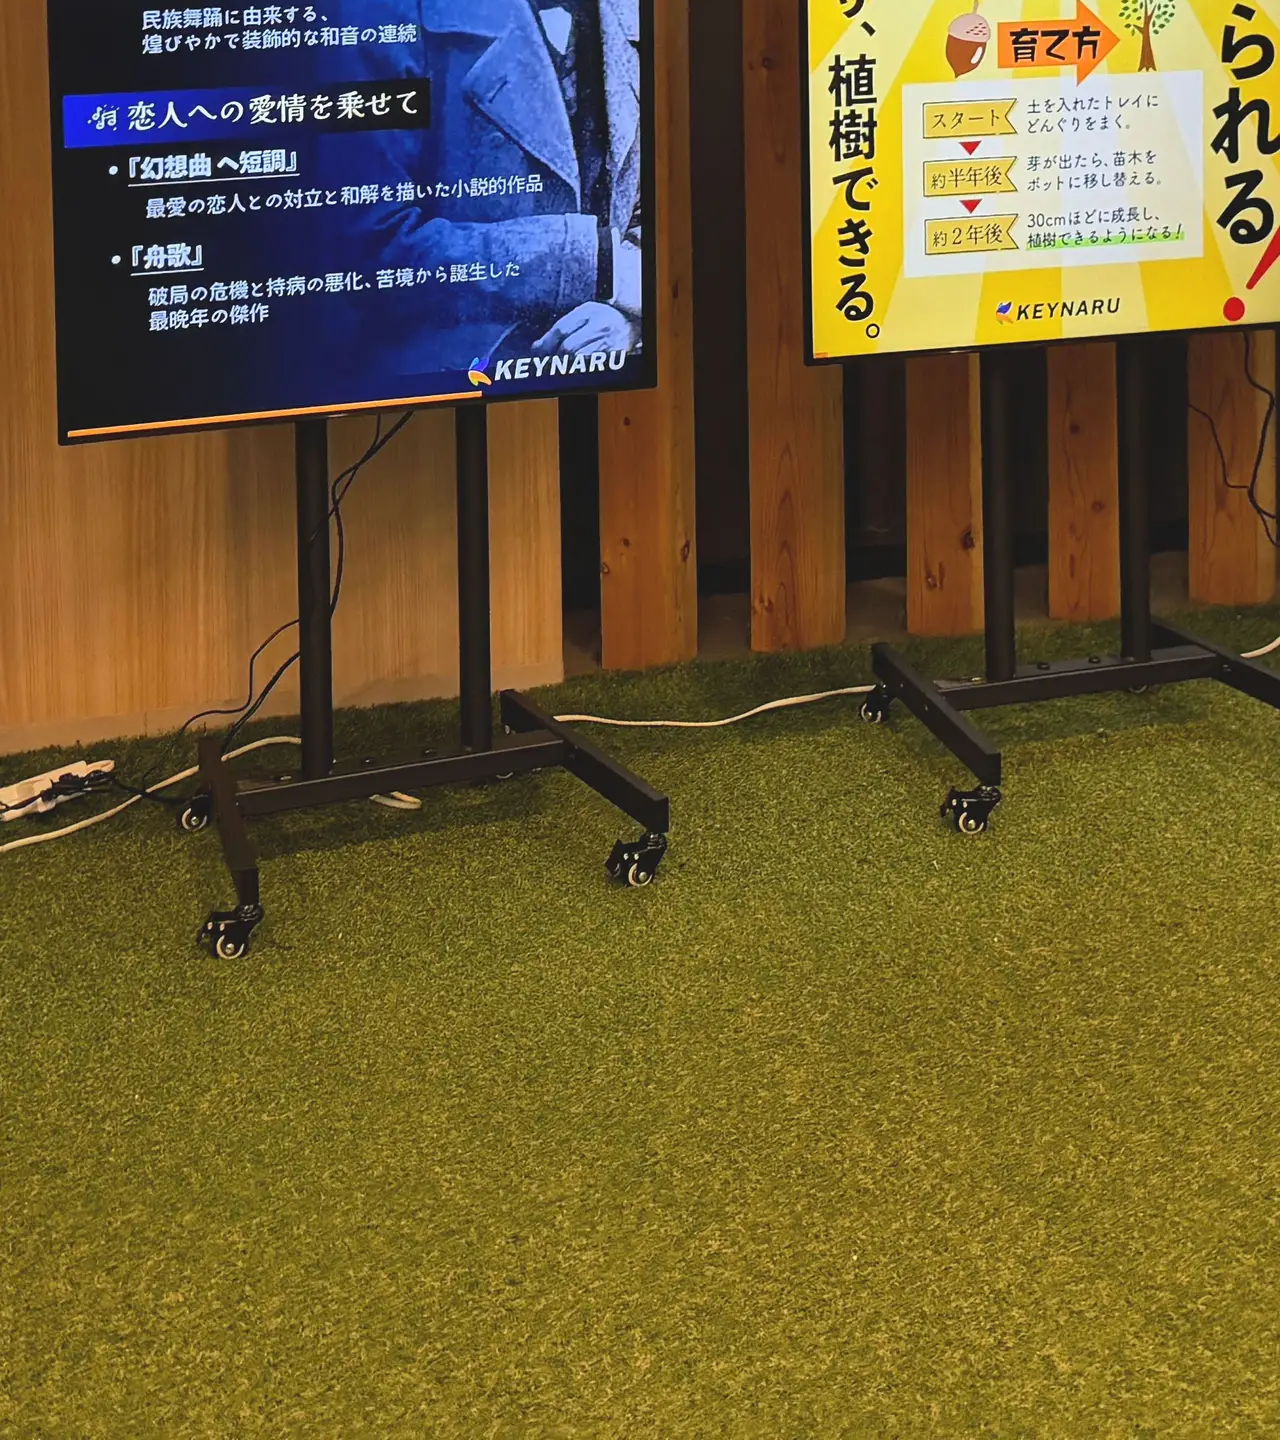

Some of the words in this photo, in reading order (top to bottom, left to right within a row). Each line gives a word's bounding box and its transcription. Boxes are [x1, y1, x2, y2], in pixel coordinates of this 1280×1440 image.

[142, 5, 329, 29] 民族舞踊に由来する、
[142, 23, 418, 54] 煌びやかで装飾的な和音の連続
[1009, 26, 1101, 63] 育て方
[127, 91, 418, 131] 恋人への愛情を乗せて
[1027, 93, 1159, 113] 土を入れたトレイに
[932, 110, 1002, 130] スタート
[1027, 113, 1133, 134] どんぐりをまく。
[1027, 150, 1157, 171] 芽が出たら、苗木を
[931, 165, 1003, 191] 約半年後
[1027, 171, 1162, 191] ポットに移し替える。
[145, 176, 544, 219] 最愛の恋人との対立と和解を描いた小説的作品
[1027, 207, 1160, 229] 30cmほどに成長し、
[932, 222, 1004, 247] 約2年後
[1027, 224, 1183, 249] 植樹できるようになる！
[131, 243, 204, 270] 『舟歌』
[148, 260, 520, 306] 破局の危機と持病の悪化、苦境から誕生した
[148, 304, 270, 332] 最晩年の傑作
[1017, 297, 1121, 320] KEYNARU
[495, 350, 627, 381] KEYNARU
